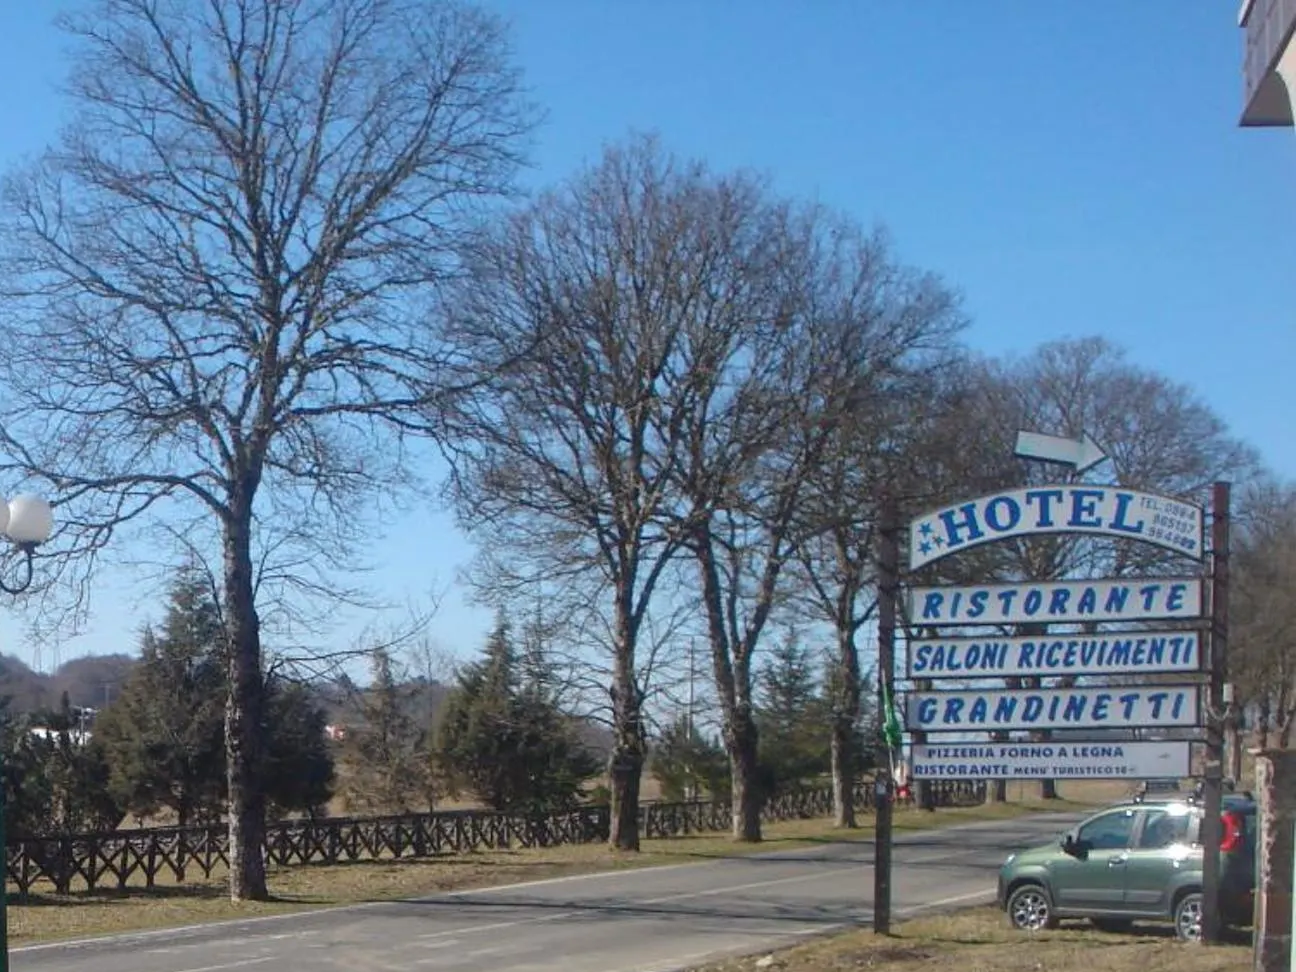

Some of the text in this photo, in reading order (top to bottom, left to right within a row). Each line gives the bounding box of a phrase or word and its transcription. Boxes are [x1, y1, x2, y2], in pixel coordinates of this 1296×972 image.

[939, 489, 1144, 547] HOTEL
[922, 584, 1187, 619] RISTORANTE
[913, 637, 1194, 672] SALONI RICEVIMENTI
[917, 692, 1185, 724] GRANDINETTI
[927, 747, 1124, 758] PIZZERIA FORNO A LEGNA
[914, 764, 1009, 775] RISTORANTE
[1053, 765, 1113, 775] TURISTICO
